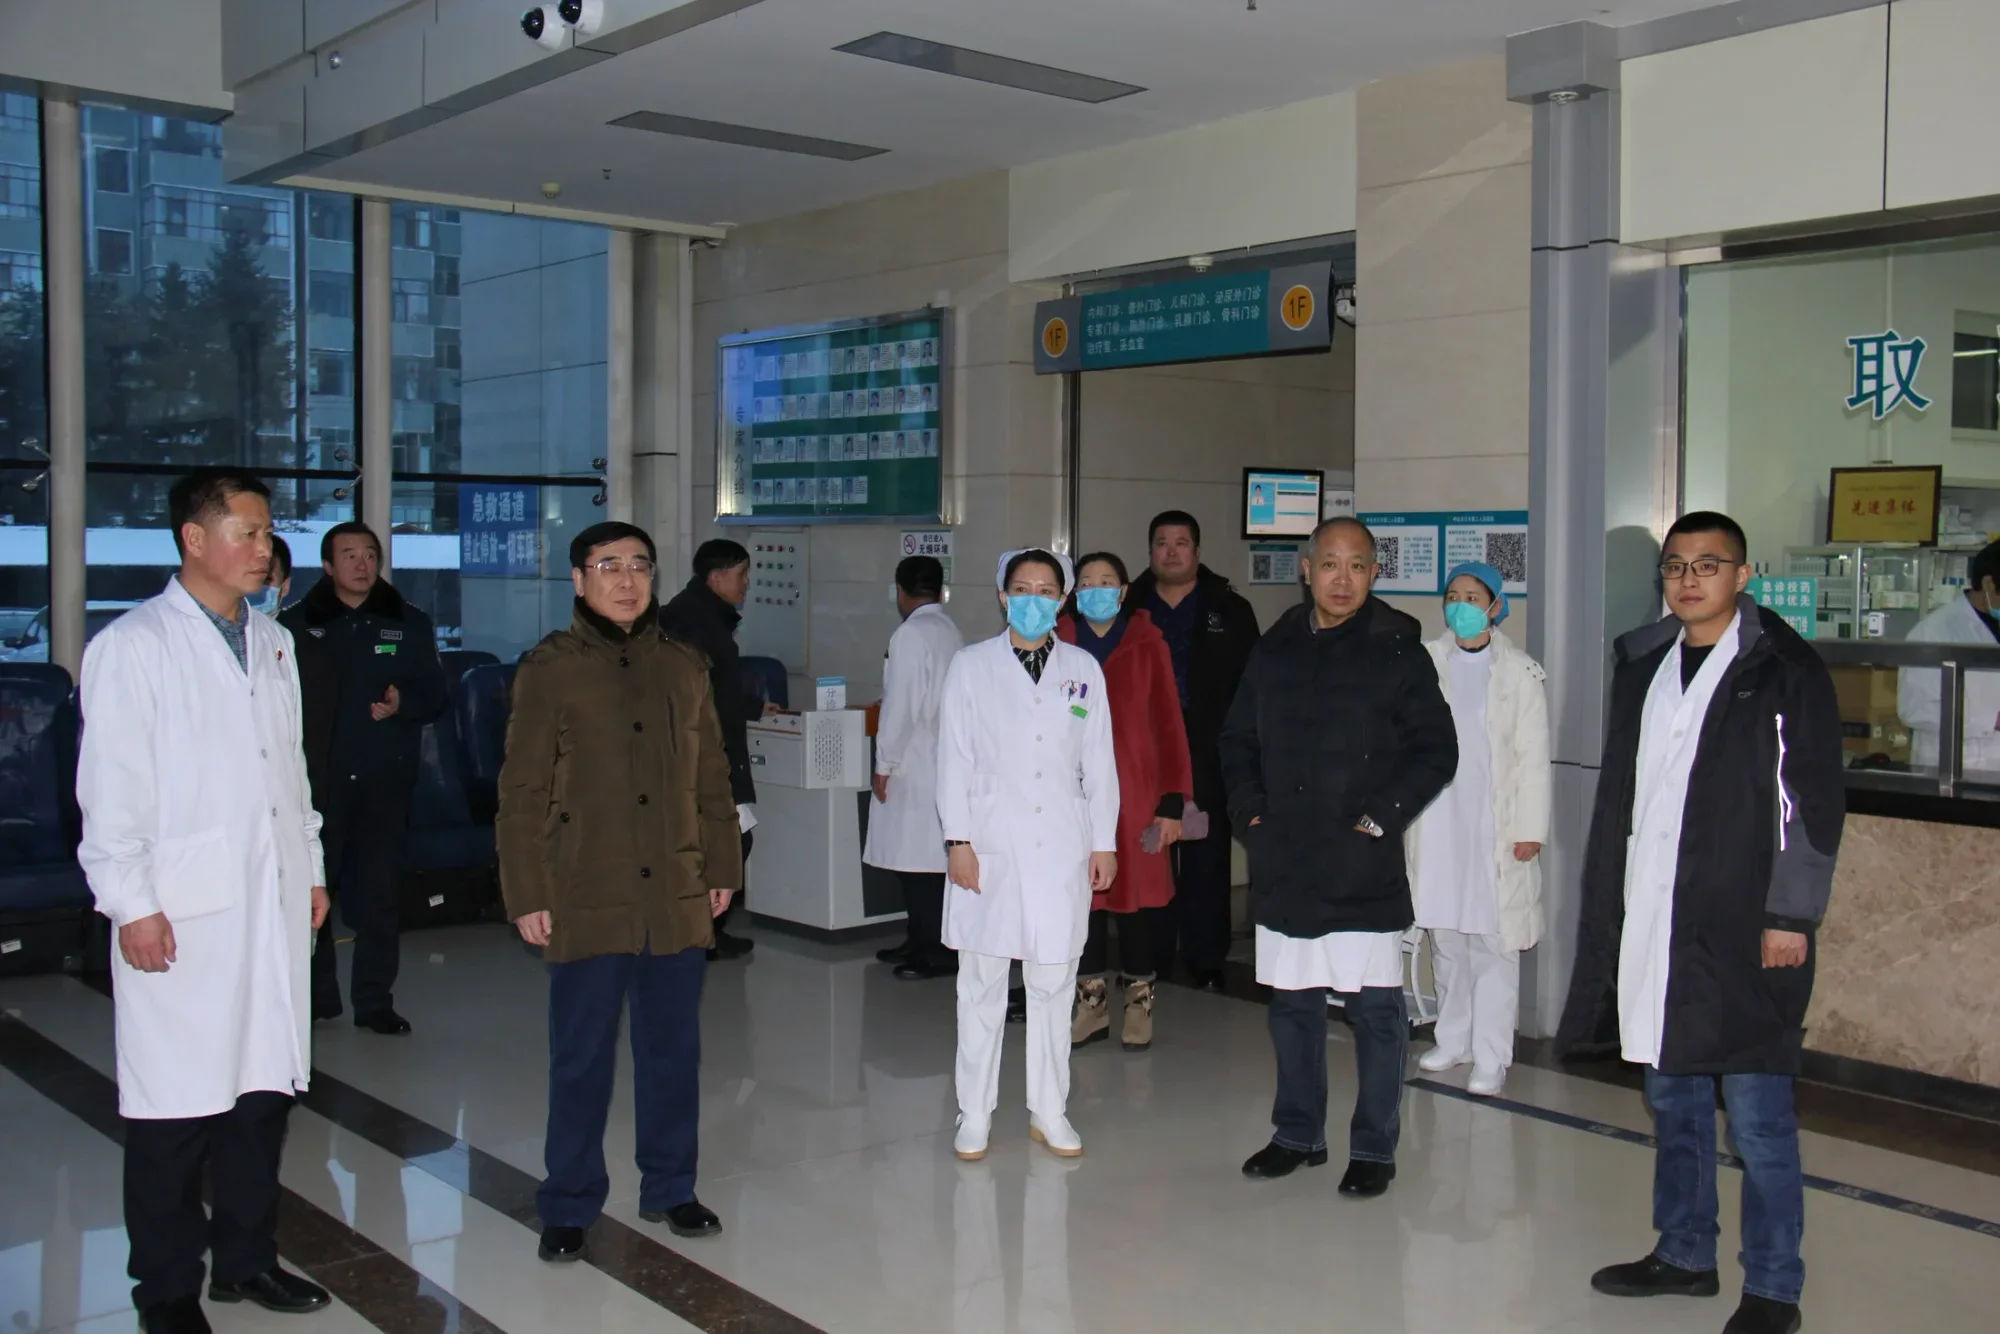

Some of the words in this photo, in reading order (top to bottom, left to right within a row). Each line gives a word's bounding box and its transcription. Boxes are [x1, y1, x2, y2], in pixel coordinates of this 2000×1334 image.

[1289, 295, 1307, 320] 1F
[1049, 327, 1063, 348] 1F
[734, 404, 746, 496] 专家介绍
[472, 490, 525, 523] 急救通道
[1851, 498, 1916, 516] 先进集体
[463, 531, 535, 566] 禁止停放一切车辆
[919, 544, 949, 555] 无烟环境
[1762, 594, 1811, 607] 急诊优先
[825, 687, 837, 711] 分诊
